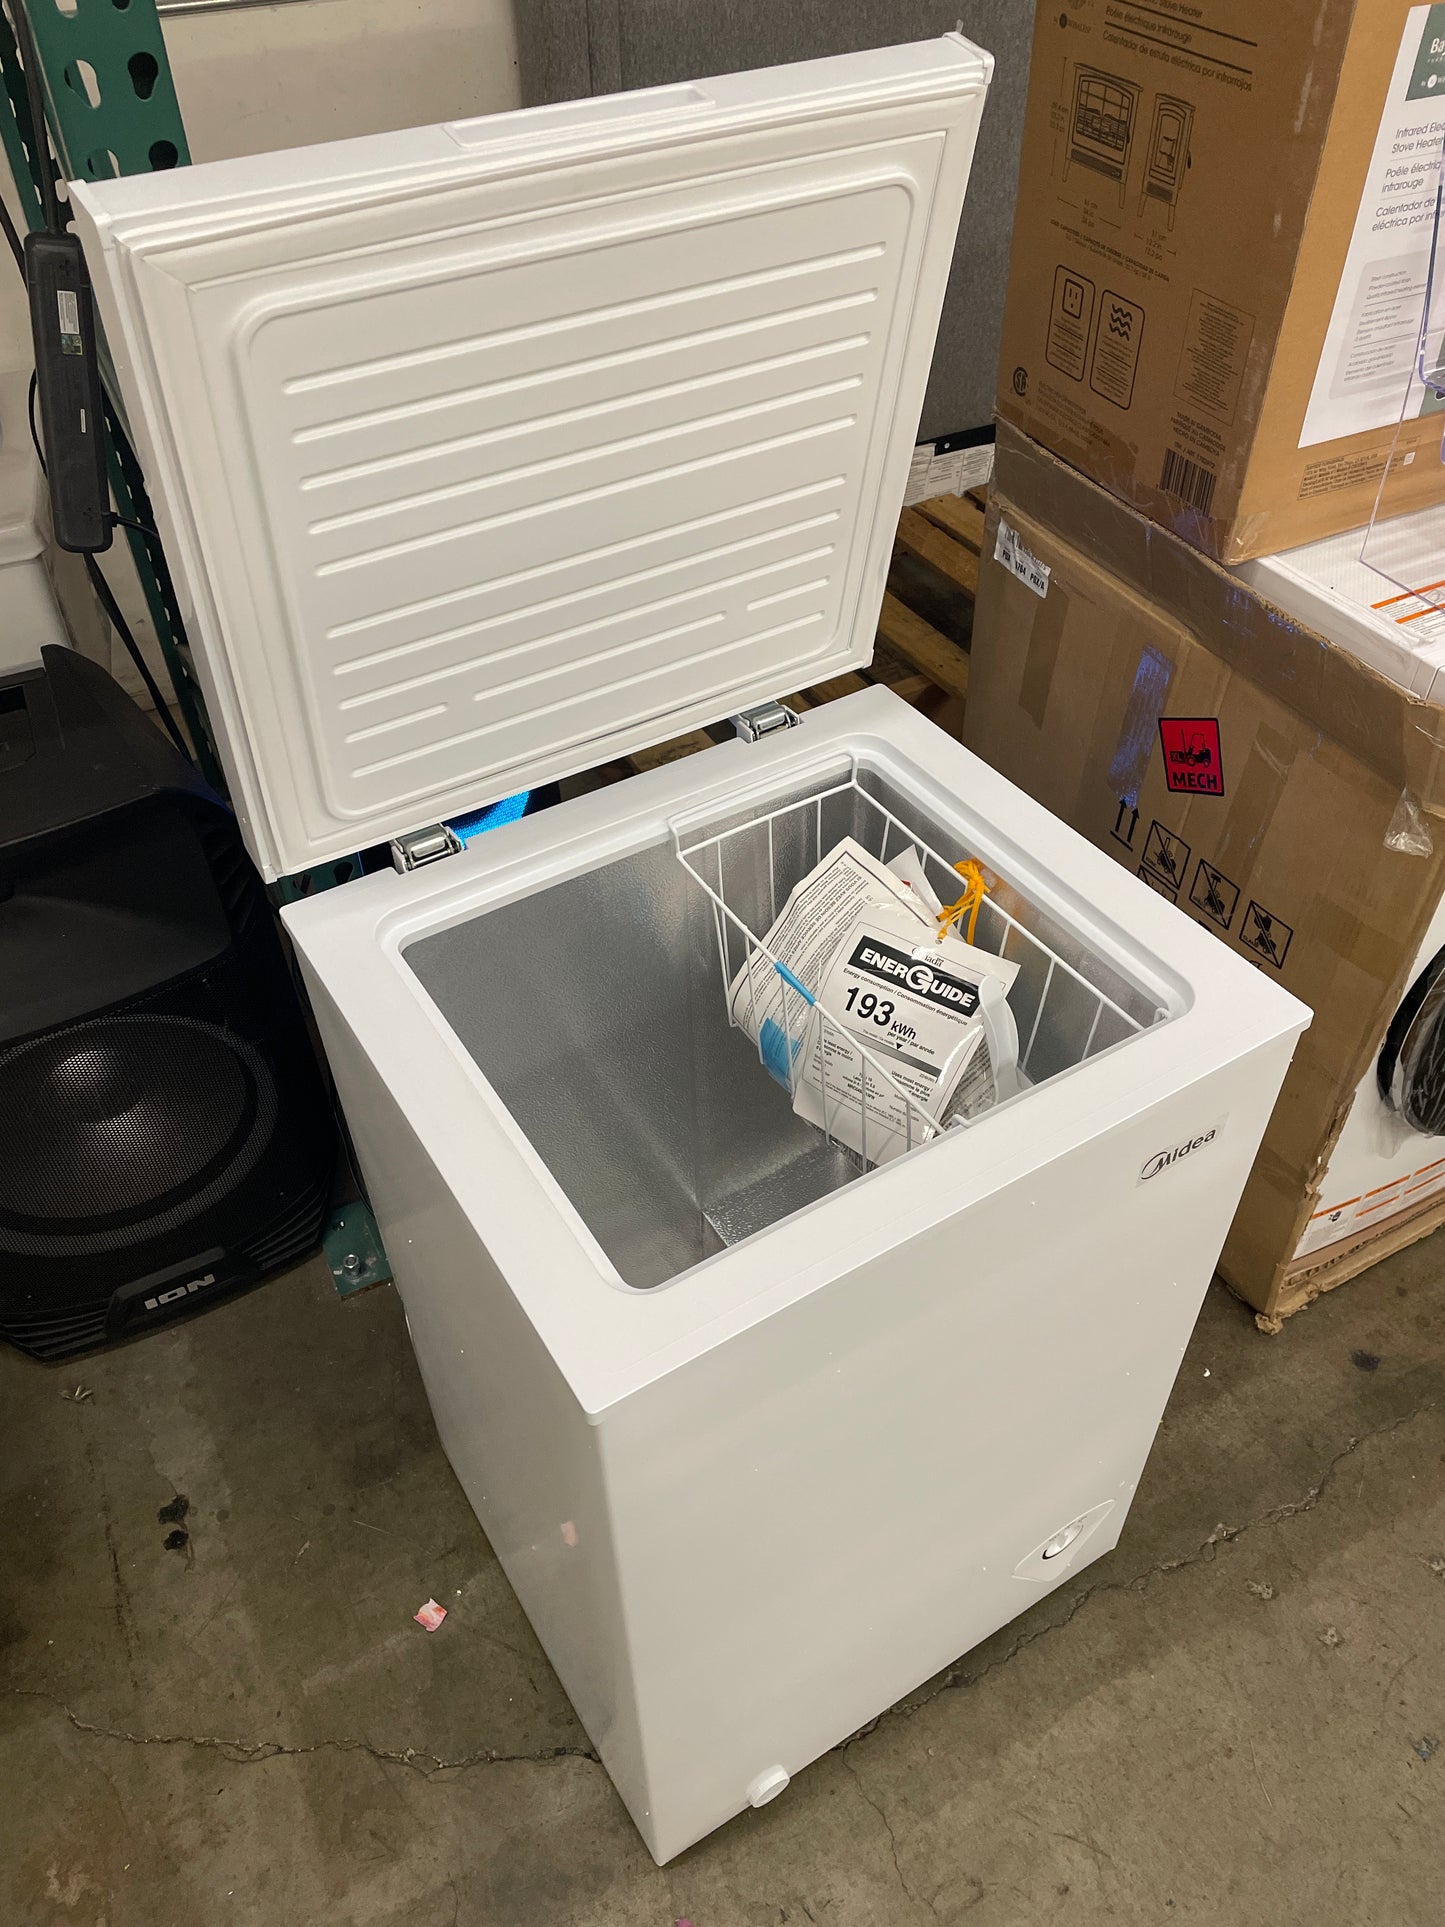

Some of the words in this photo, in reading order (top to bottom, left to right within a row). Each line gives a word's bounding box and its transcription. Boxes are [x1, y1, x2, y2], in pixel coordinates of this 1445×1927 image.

[1179, 4, 1202, 18] Heater
[1139, 44, 1148, 54] de
[1202, 67, 1215, 77] por
[1396, 123, 1428, 140] Infrared
[1392, 139, 1416, 154] Stove
[1416, 136, 1444, 150] Heater
[1385, 163, 1409, 178] Poêle
[1382, 177, 1424, 193] infrarouge
[1376, 199, 1422, 218] Calentador
[1422, 198, 1435, 209] de
[1372, 216, 1408, 232] eléctrica
[1408, 215, 1424, 228] por
[1172, 772, 1217, 790] MECH
[846, 880, 857, 891] VOUS
[836, 891, 846, 902] AVEZ
[820, 901, 836, 917] BESOIN
[801, 922, 816, 939] SERVICE
[860, 948, 976, 1008] ENERGUIDE
[843, 967, 860, 979] Energy
[860, 976, 894, 994] consumption
[897, 991, 936, 1012] Consommation
[936, 1007, 968, 1026] énergétique
[845, 987, 895, 1026] 193
[890, 1020, 916, 1040] kWh
[896, 1034, 908, 1044] year
[910, 1040, 919, 1048] par
[919, 1044, 935, 1054] année
[892, 1070, 902, 1080] Uses
[913, 1079, 930, 1092] energy
[1141, 1130, 1216, 1180] Midea
